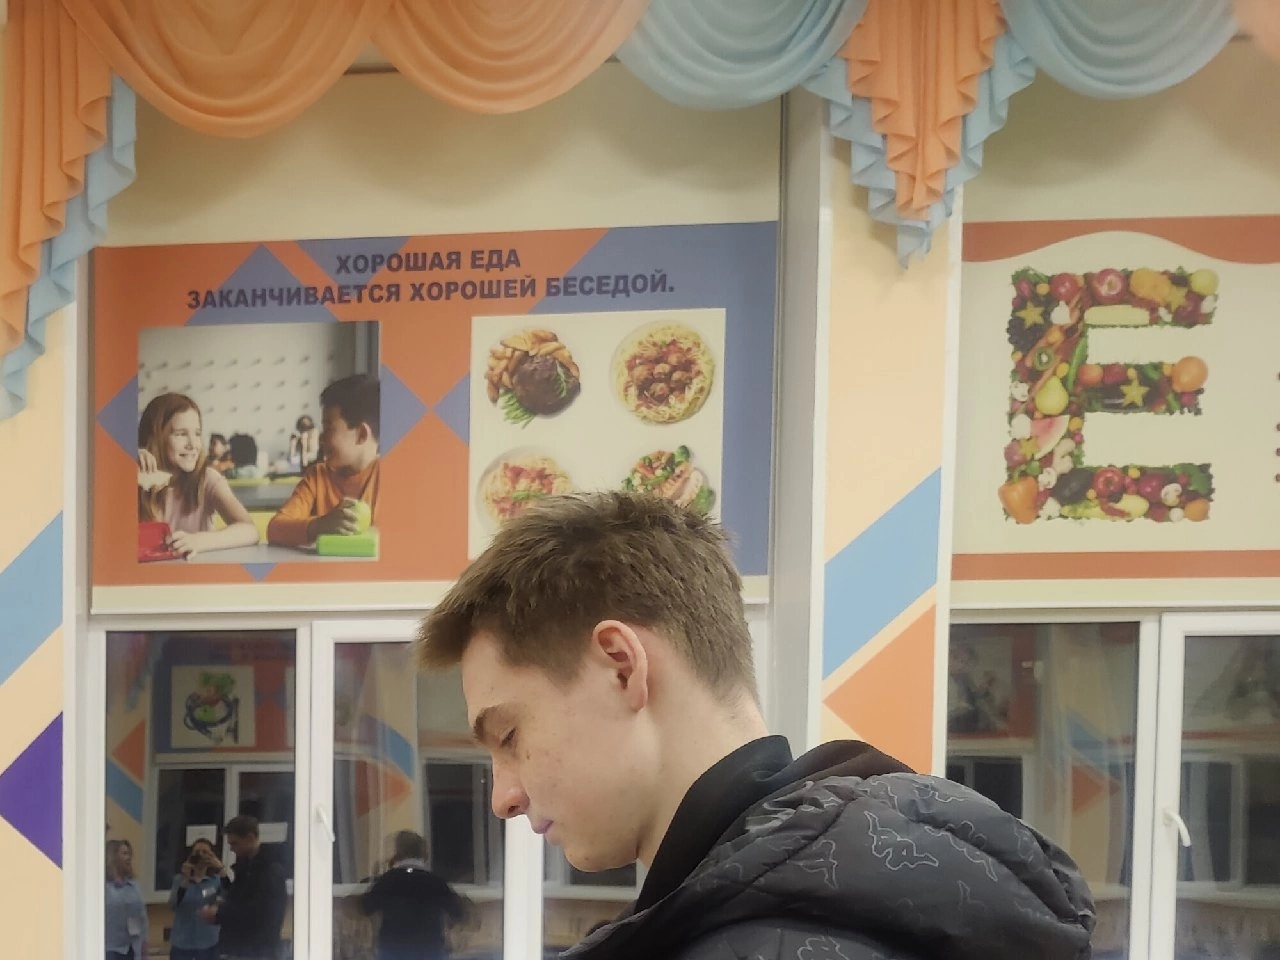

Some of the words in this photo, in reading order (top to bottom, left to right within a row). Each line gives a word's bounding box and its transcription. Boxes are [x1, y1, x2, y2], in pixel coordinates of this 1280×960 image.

[335, 251, 462, 276] ХОРОШАЯ
[470, 248, 521, 271] ЕДА
[187, 284, 401, 310] ЗАКАНЧИВАЕТСЯ
[409, 275, 537, 302] ХОРОШЕЙ
[545, 269, 675, 298] БЕСЕДОЙ.
